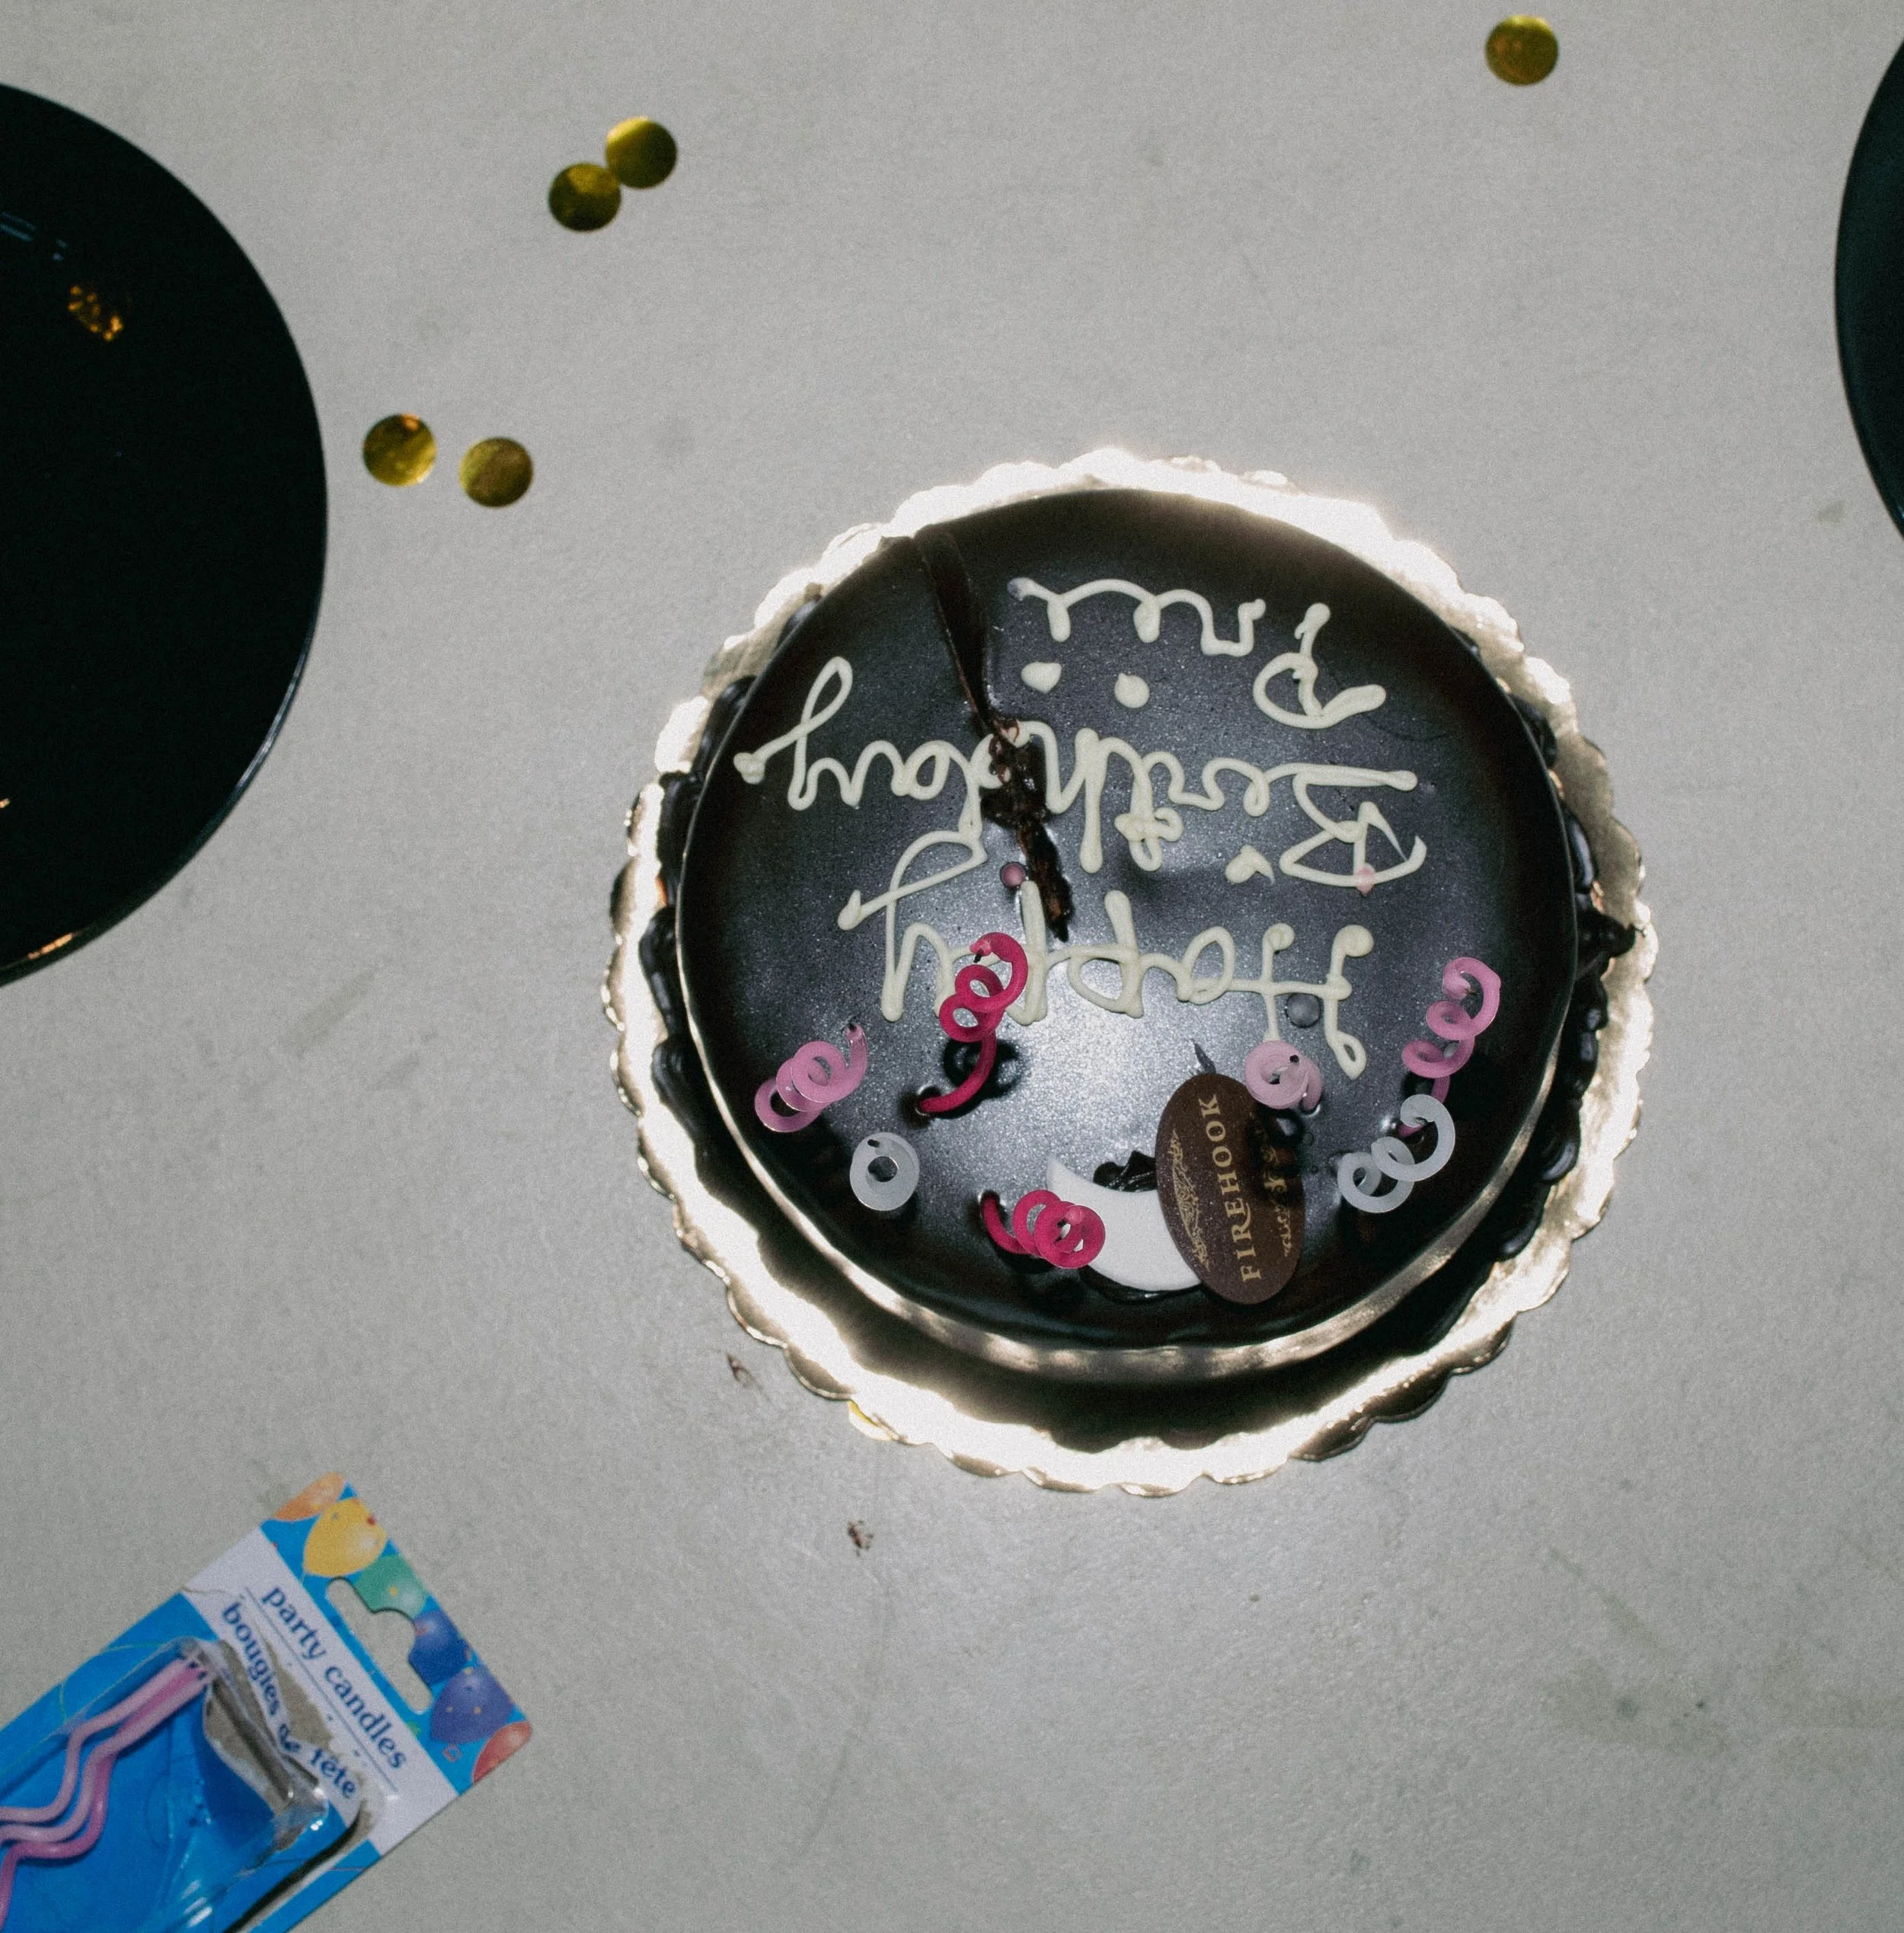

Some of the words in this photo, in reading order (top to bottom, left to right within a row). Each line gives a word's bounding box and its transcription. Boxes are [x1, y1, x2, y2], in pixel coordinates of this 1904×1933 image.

[733, 656, 1428, 890] Birthday
[838, 830, 1374, 1079] Happy
[1197, 1094, 1262, 1282] FIREHOOK
[222, 1601, 280, 1716] bougies
[261, 1586, 327, 1660] party
[324, 1665, 407, 1769] candles
